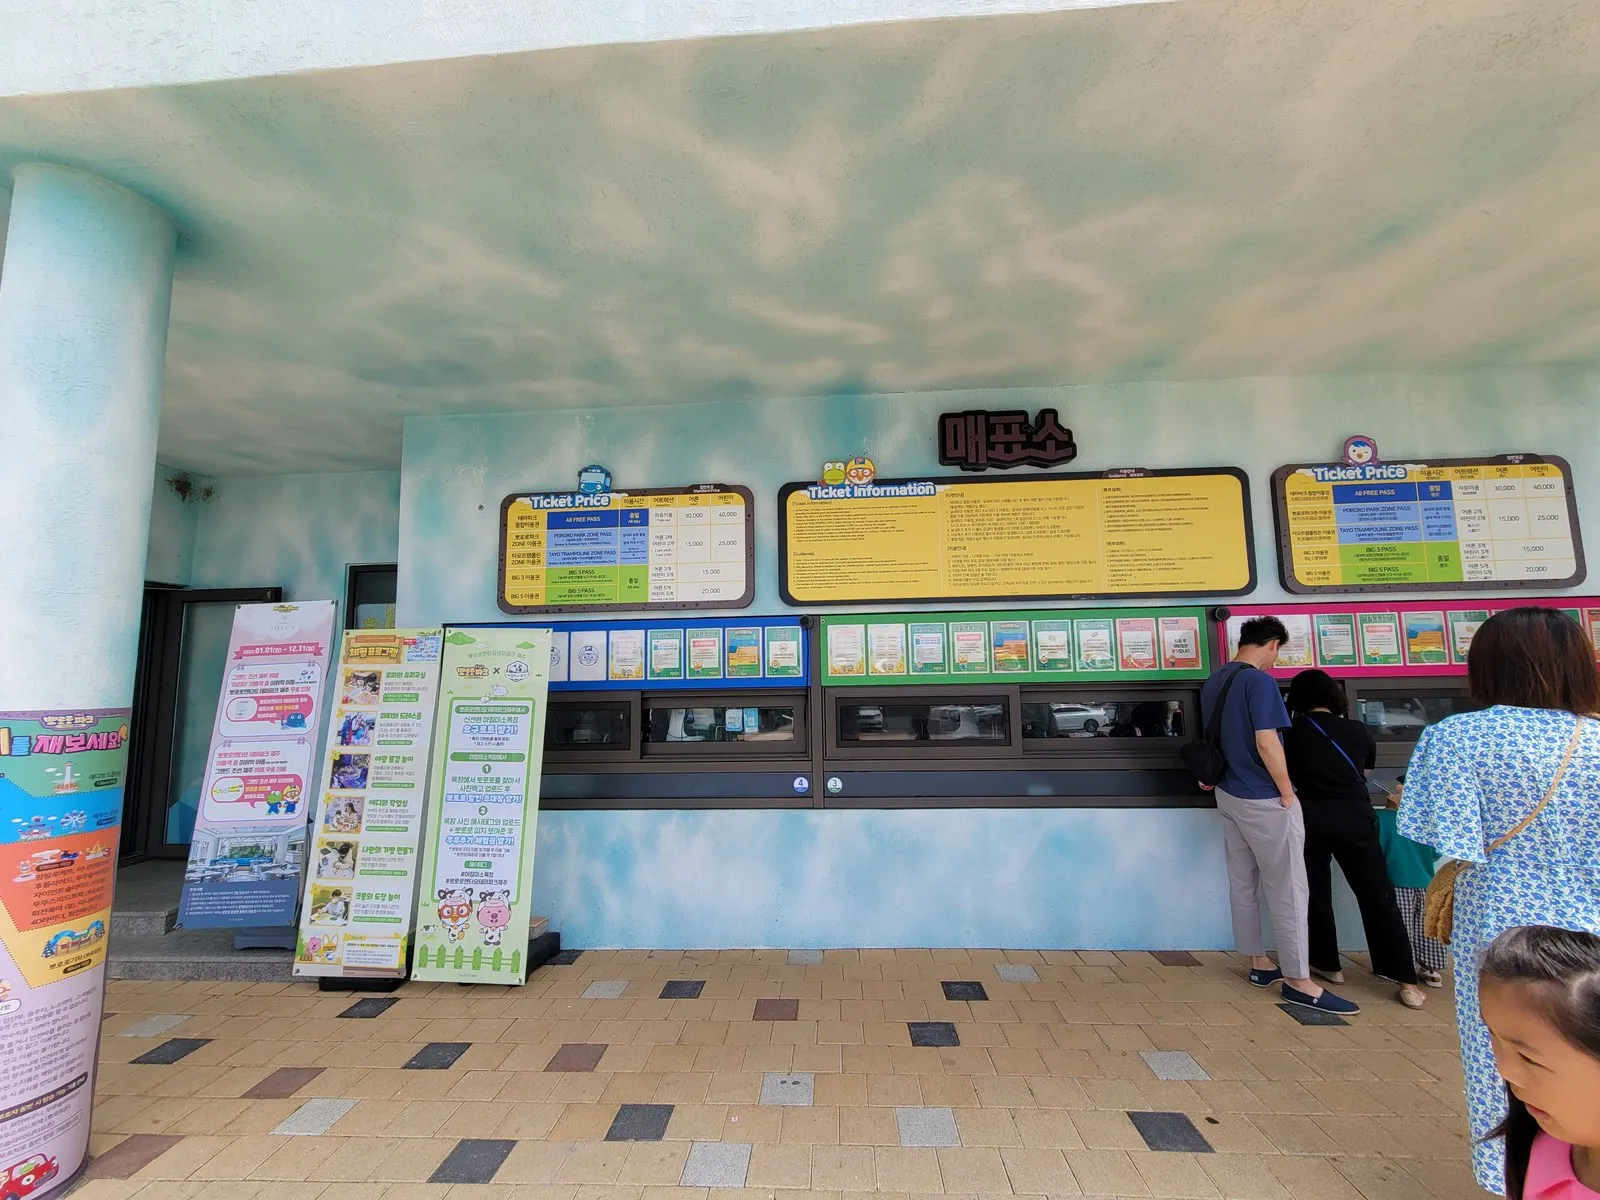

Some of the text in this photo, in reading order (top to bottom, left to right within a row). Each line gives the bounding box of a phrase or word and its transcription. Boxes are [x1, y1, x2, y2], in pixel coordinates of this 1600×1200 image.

[945, 412, 1074, 464] 매표소
[1313, 466, 1407, 481] Ticket Price
[809, 484, 935, 499] Ticket Information
[531, 494, 610, 509] Ticket Price
[349, 646, 400, 658] 체험프로그램
[462, 725, 518, 735] 요구르트 받기!
[389, 799, 408, 807] 작업실
[468, 794, 483, 803] 할인
[505, 795, 523, 804] 받기!
[502, 818, 520, 826] 업로드
[497, 836, 514, 846] 받기!
